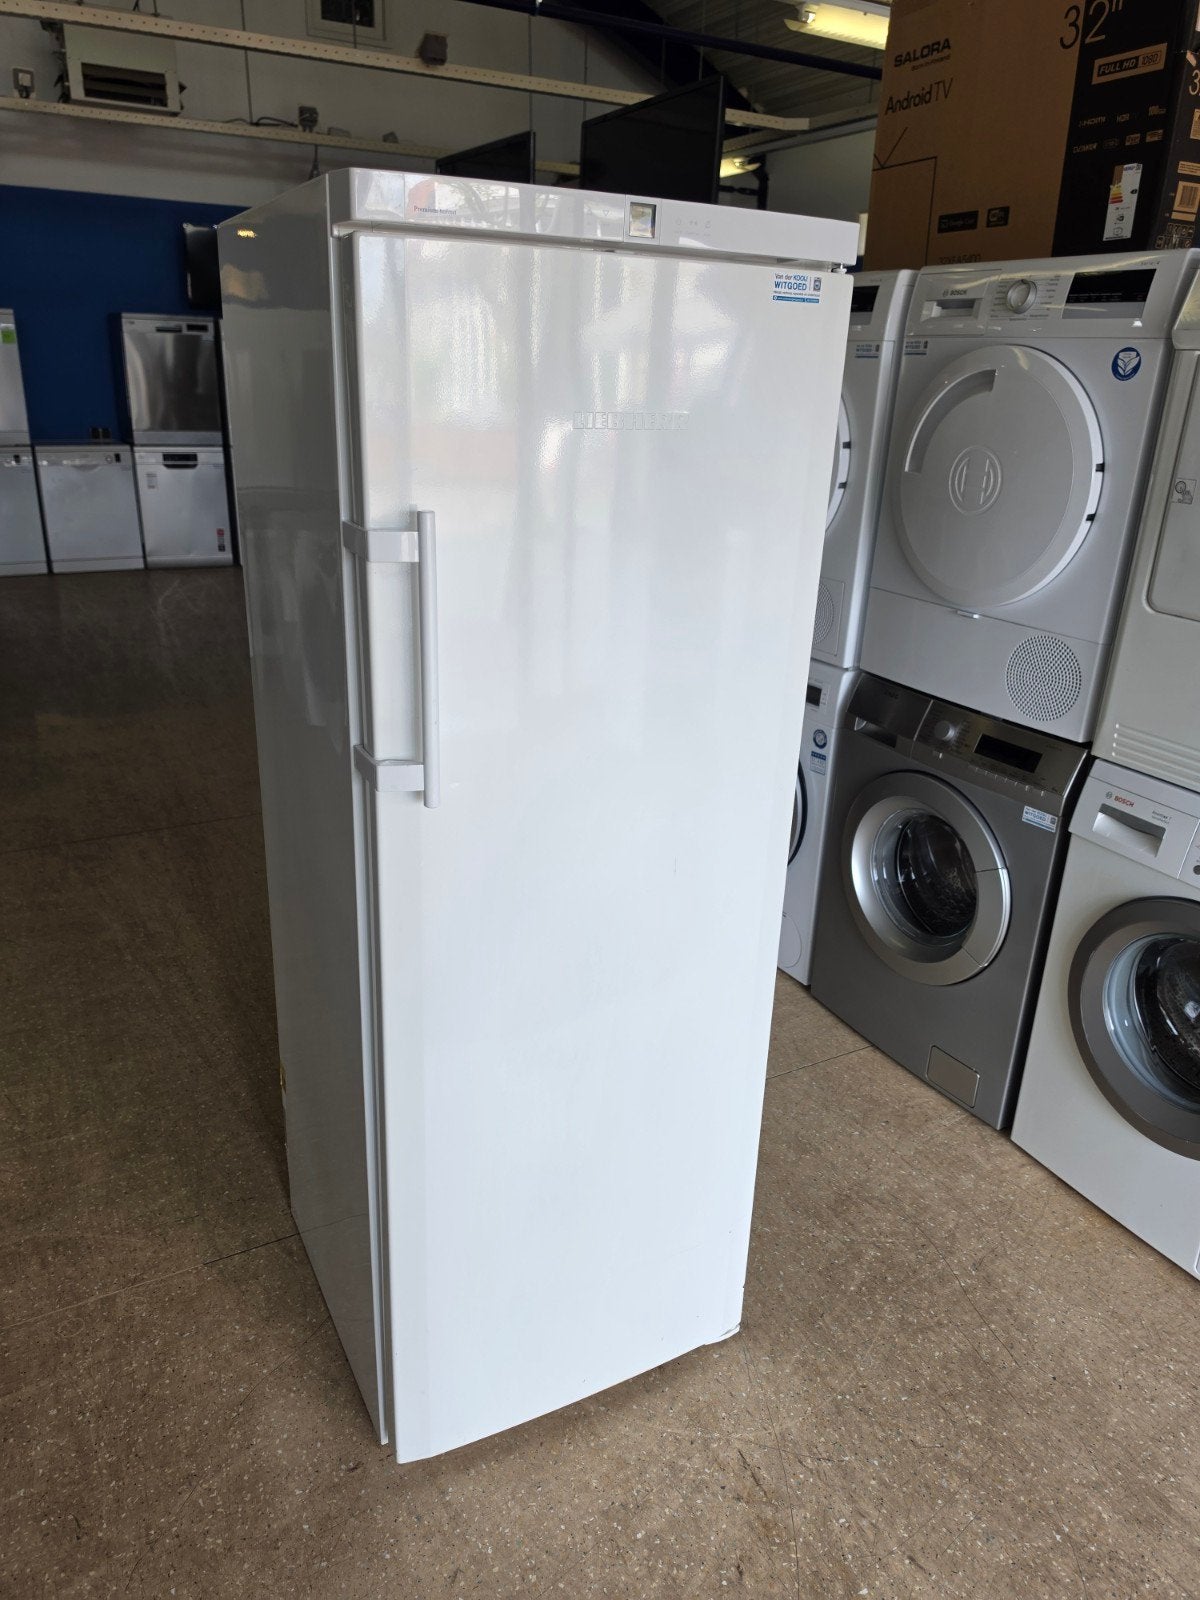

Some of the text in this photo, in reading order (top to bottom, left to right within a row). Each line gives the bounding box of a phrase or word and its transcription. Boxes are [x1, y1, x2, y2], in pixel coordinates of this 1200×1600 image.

[894, 38, 951, 67] SALORA
[1099, 61, 1121, 75] FULL
[1122, 58, 1136, 70] HD
[774, 281, 807, 291] WITGOED
[1114, 795, 1135, 808] BOSCH
